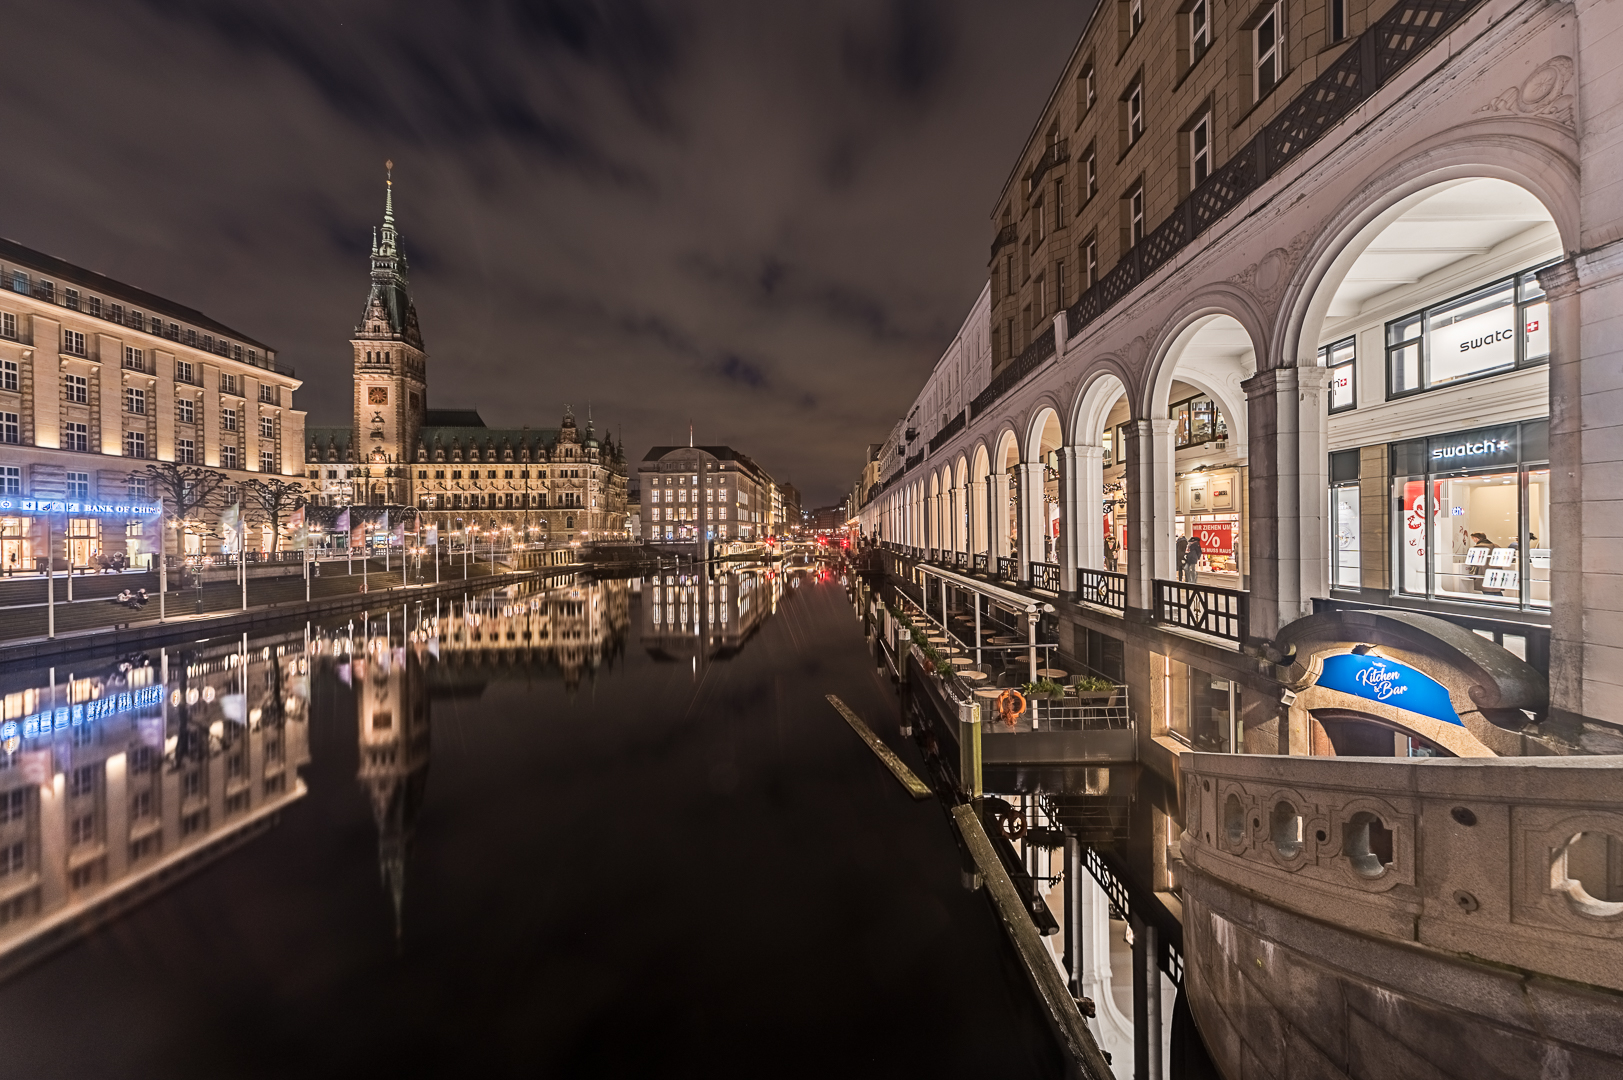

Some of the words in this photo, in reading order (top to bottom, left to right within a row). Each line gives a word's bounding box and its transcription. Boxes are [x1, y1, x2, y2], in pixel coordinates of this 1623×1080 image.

[1460, 329, 1513, 353] swatc
[1432, 439, 1496, 460] swatch
[84, 504, 114, 513] BANK
[116, 505, 130, 514] OF
[1356, 667, 1400, 686] Kitchen
[1378, 680, 1408, 700] Bar
